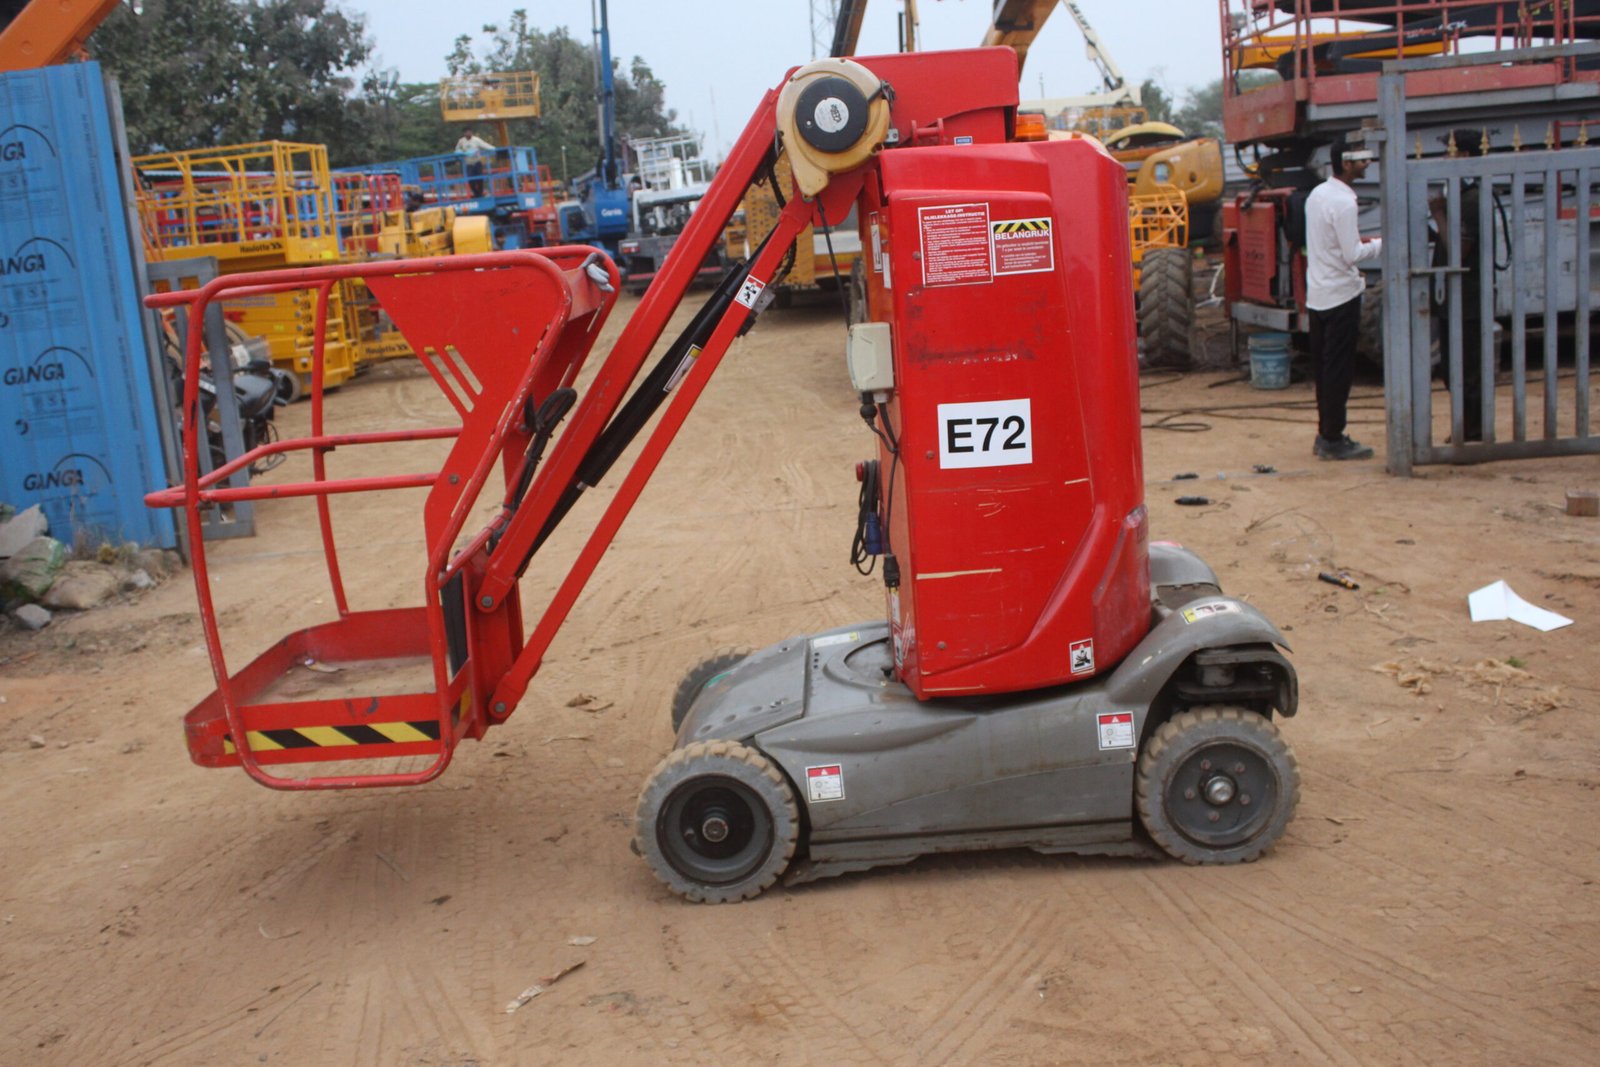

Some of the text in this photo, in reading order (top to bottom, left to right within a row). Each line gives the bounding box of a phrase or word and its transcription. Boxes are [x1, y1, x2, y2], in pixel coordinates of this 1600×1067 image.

[994, 229, 1050, 240] BELANGRIJK
[4, 363, 65, 386] GANGA
[947, 415, 1026, 453] E72
[24, 469, 84, 491] GANGA
